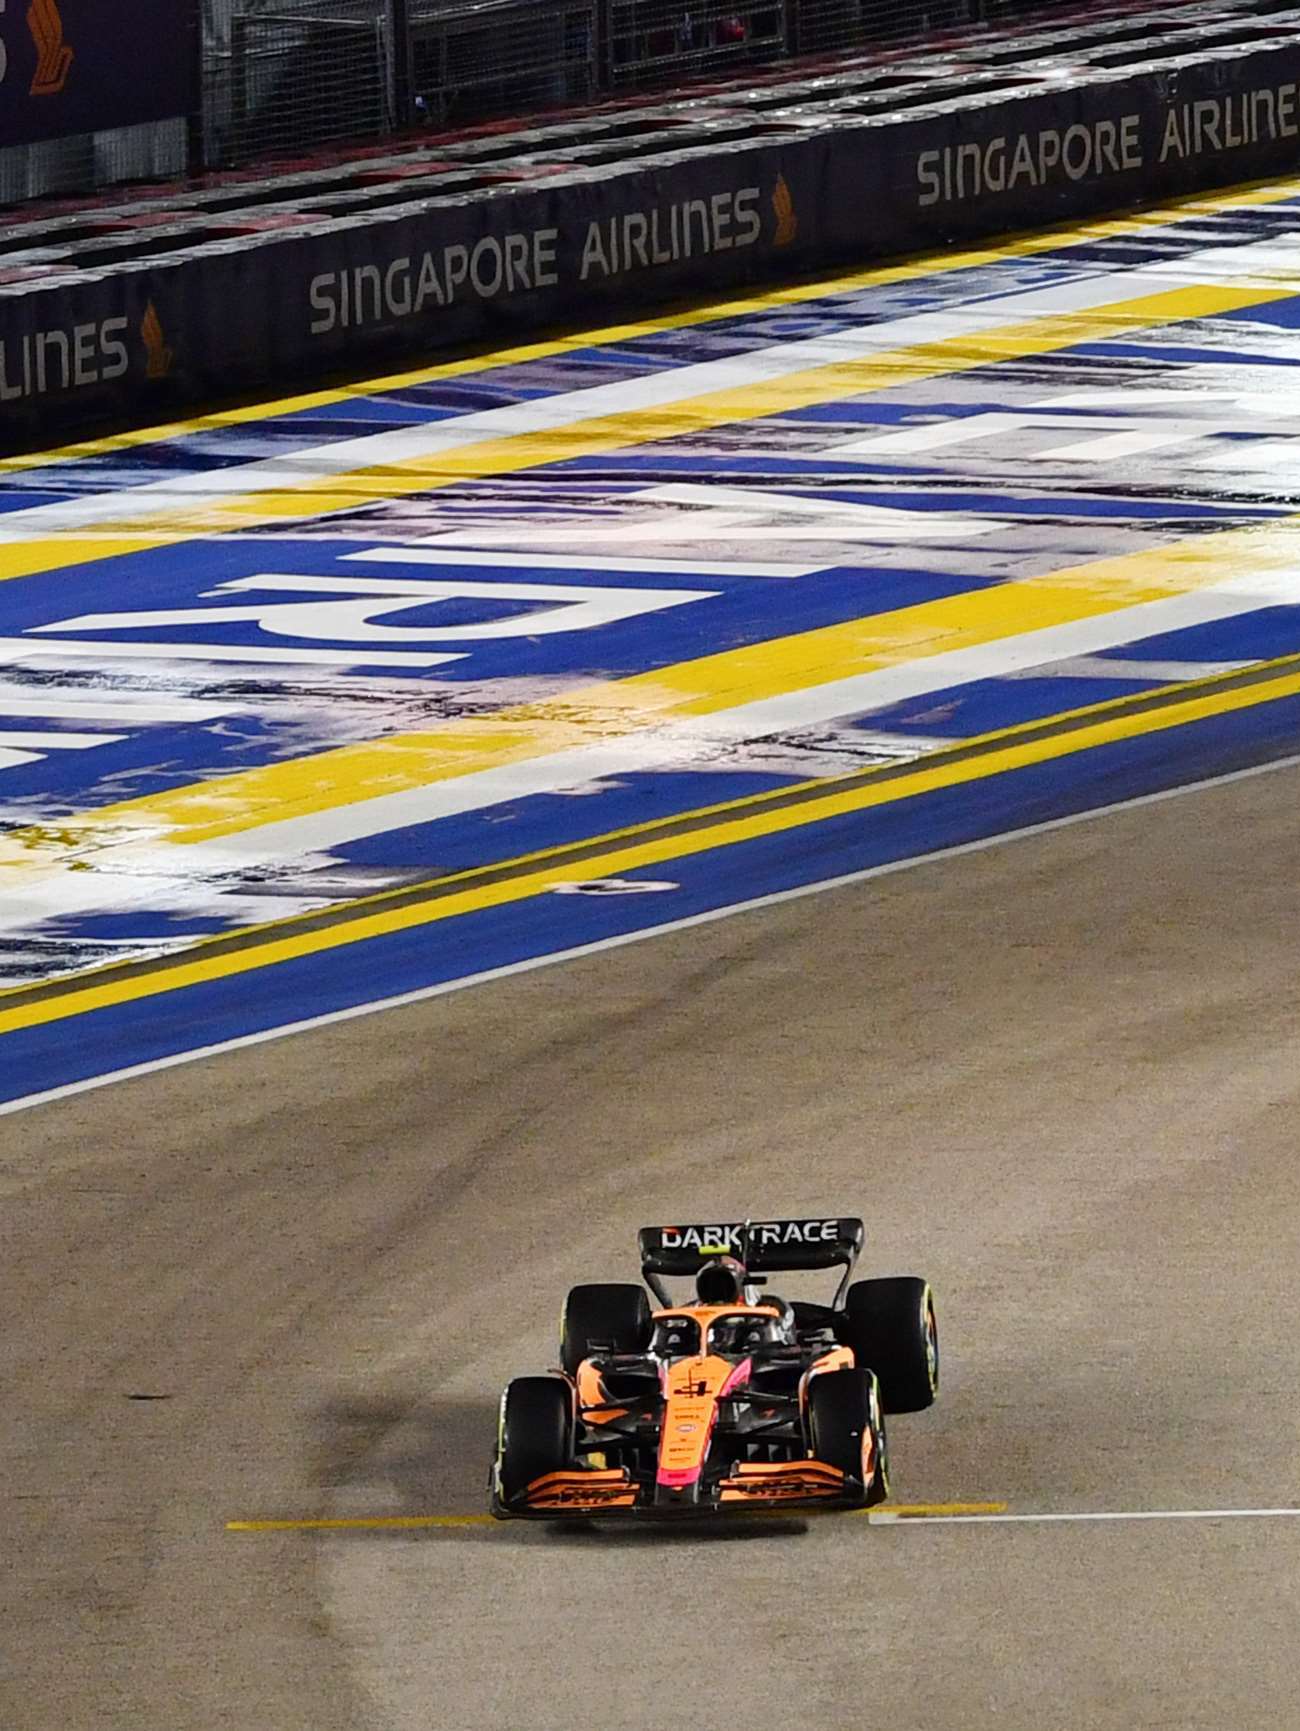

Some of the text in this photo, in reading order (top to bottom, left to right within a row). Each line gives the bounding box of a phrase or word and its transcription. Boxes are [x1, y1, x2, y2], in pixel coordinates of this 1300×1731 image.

[917, 115, 1142, 206] SINGAPORE
[310, 187, 761, 334] SINGAPORE AIRLINES
[661, 1220, 839, 1248] DARKTRACE
